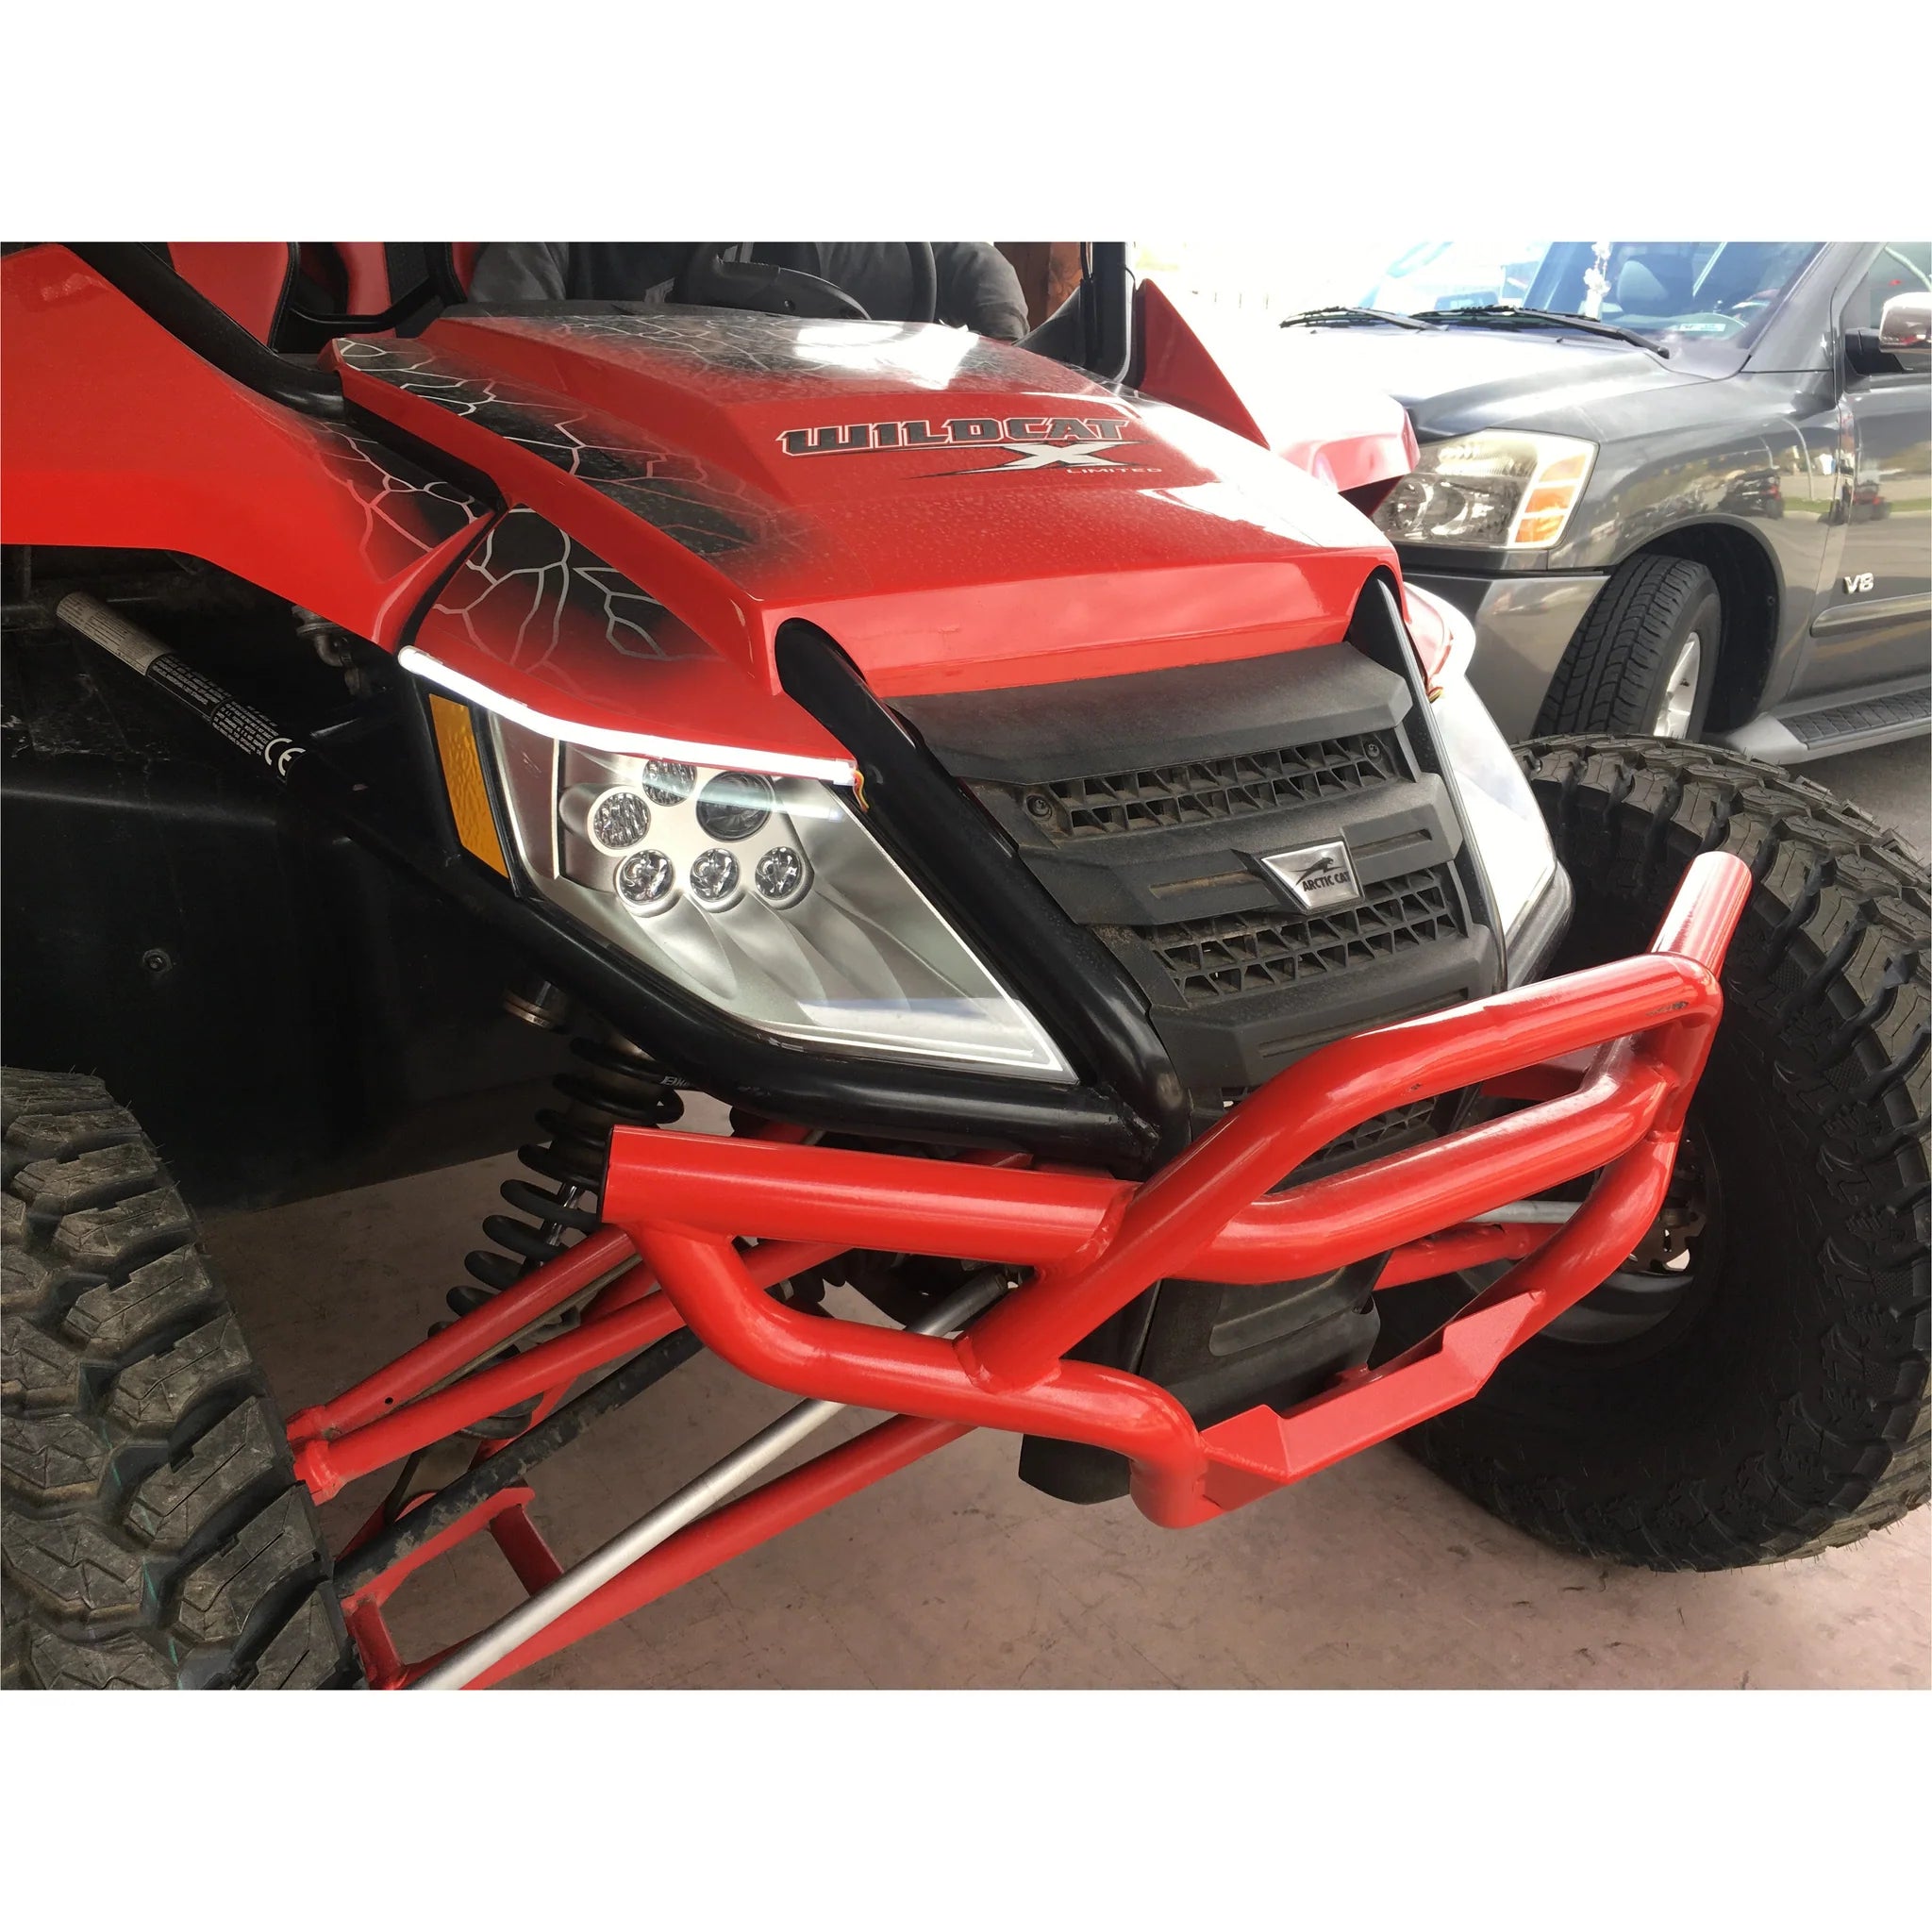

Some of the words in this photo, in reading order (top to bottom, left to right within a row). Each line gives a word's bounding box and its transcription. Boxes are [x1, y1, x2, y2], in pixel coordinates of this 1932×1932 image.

[776, 417, 1129, 457] WILDCAT
[1844, 572, 1874, 594] V8
[1302, 874, 1335, 892] ARCTIC
[1334, 871, 1352, 884] CAT
